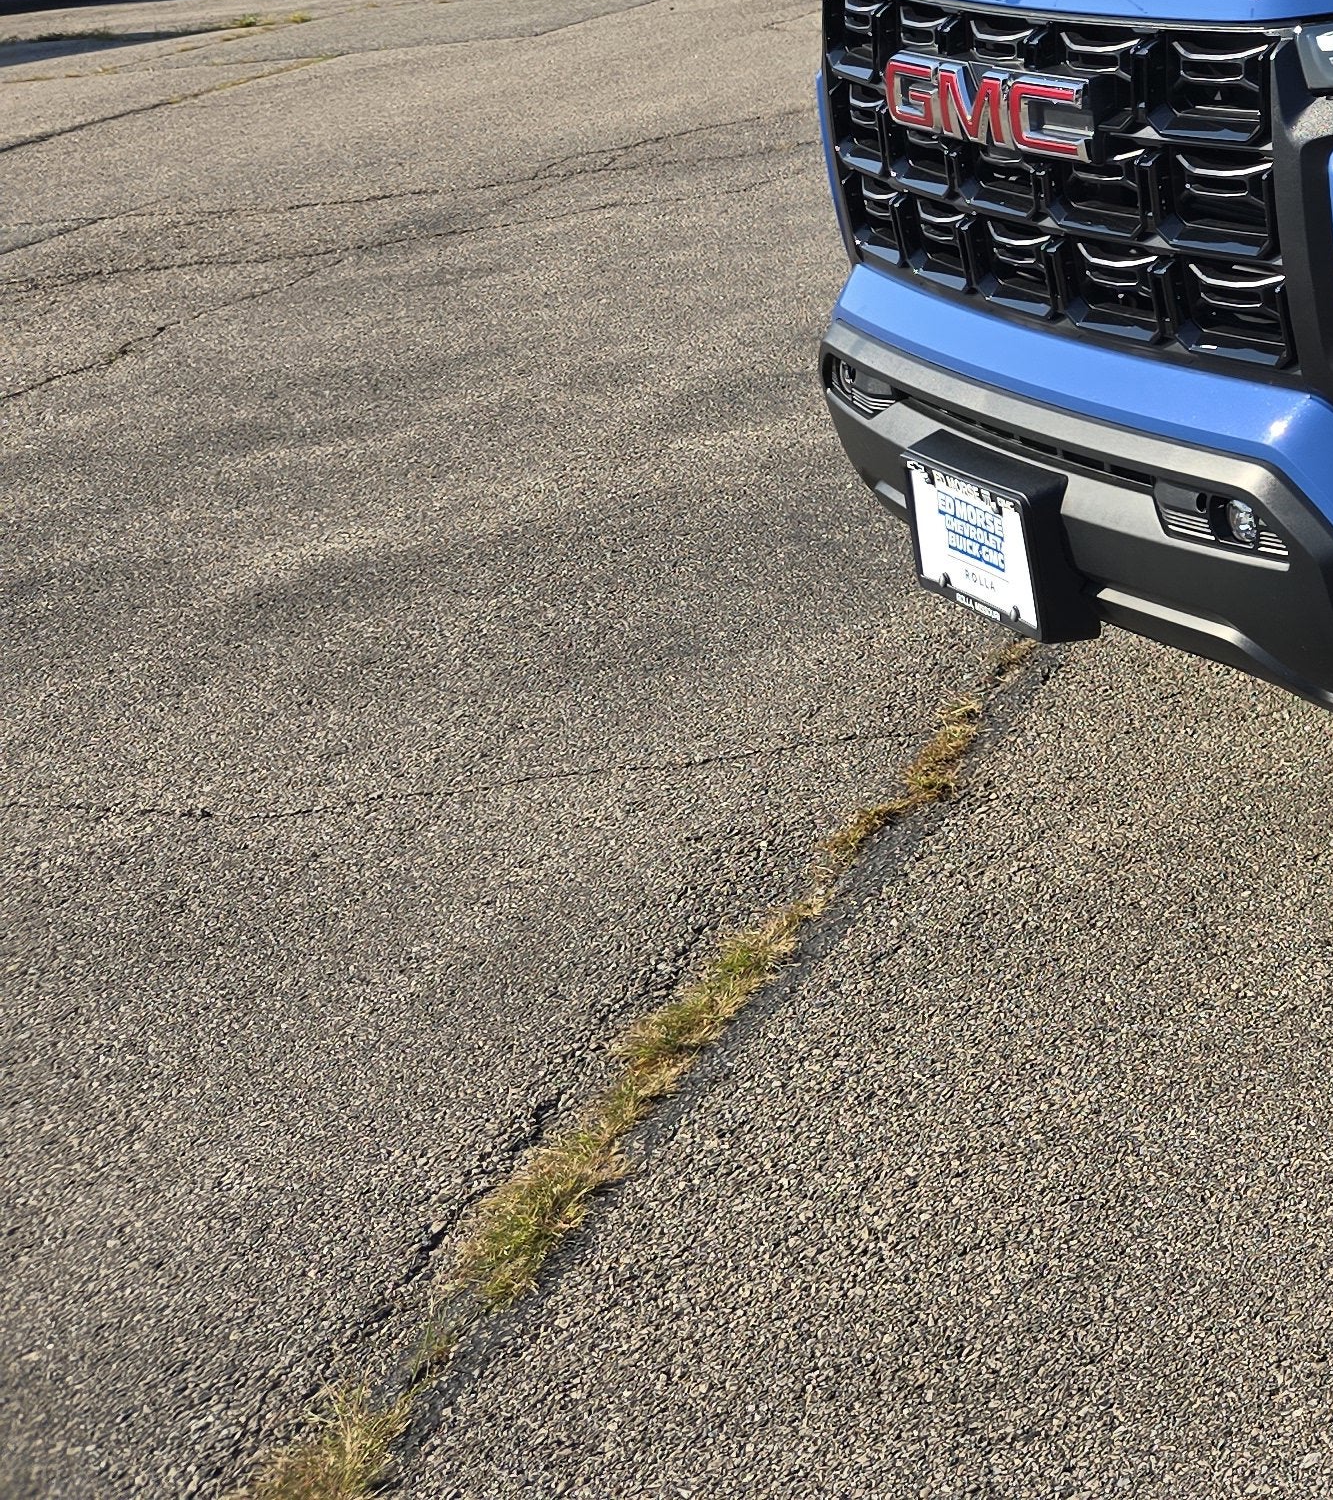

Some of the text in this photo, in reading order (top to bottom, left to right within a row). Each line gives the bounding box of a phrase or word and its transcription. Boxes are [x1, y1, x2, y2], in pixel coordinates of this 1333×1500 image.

[884, 50, 1093, 164] GMC
[937, 490, 955, 516] ED
[955, 497, 1003, 537] MORSE
[945, 514, 1003, 550] CHEVROLET
[964, 569, 996, 592] ROLLA
